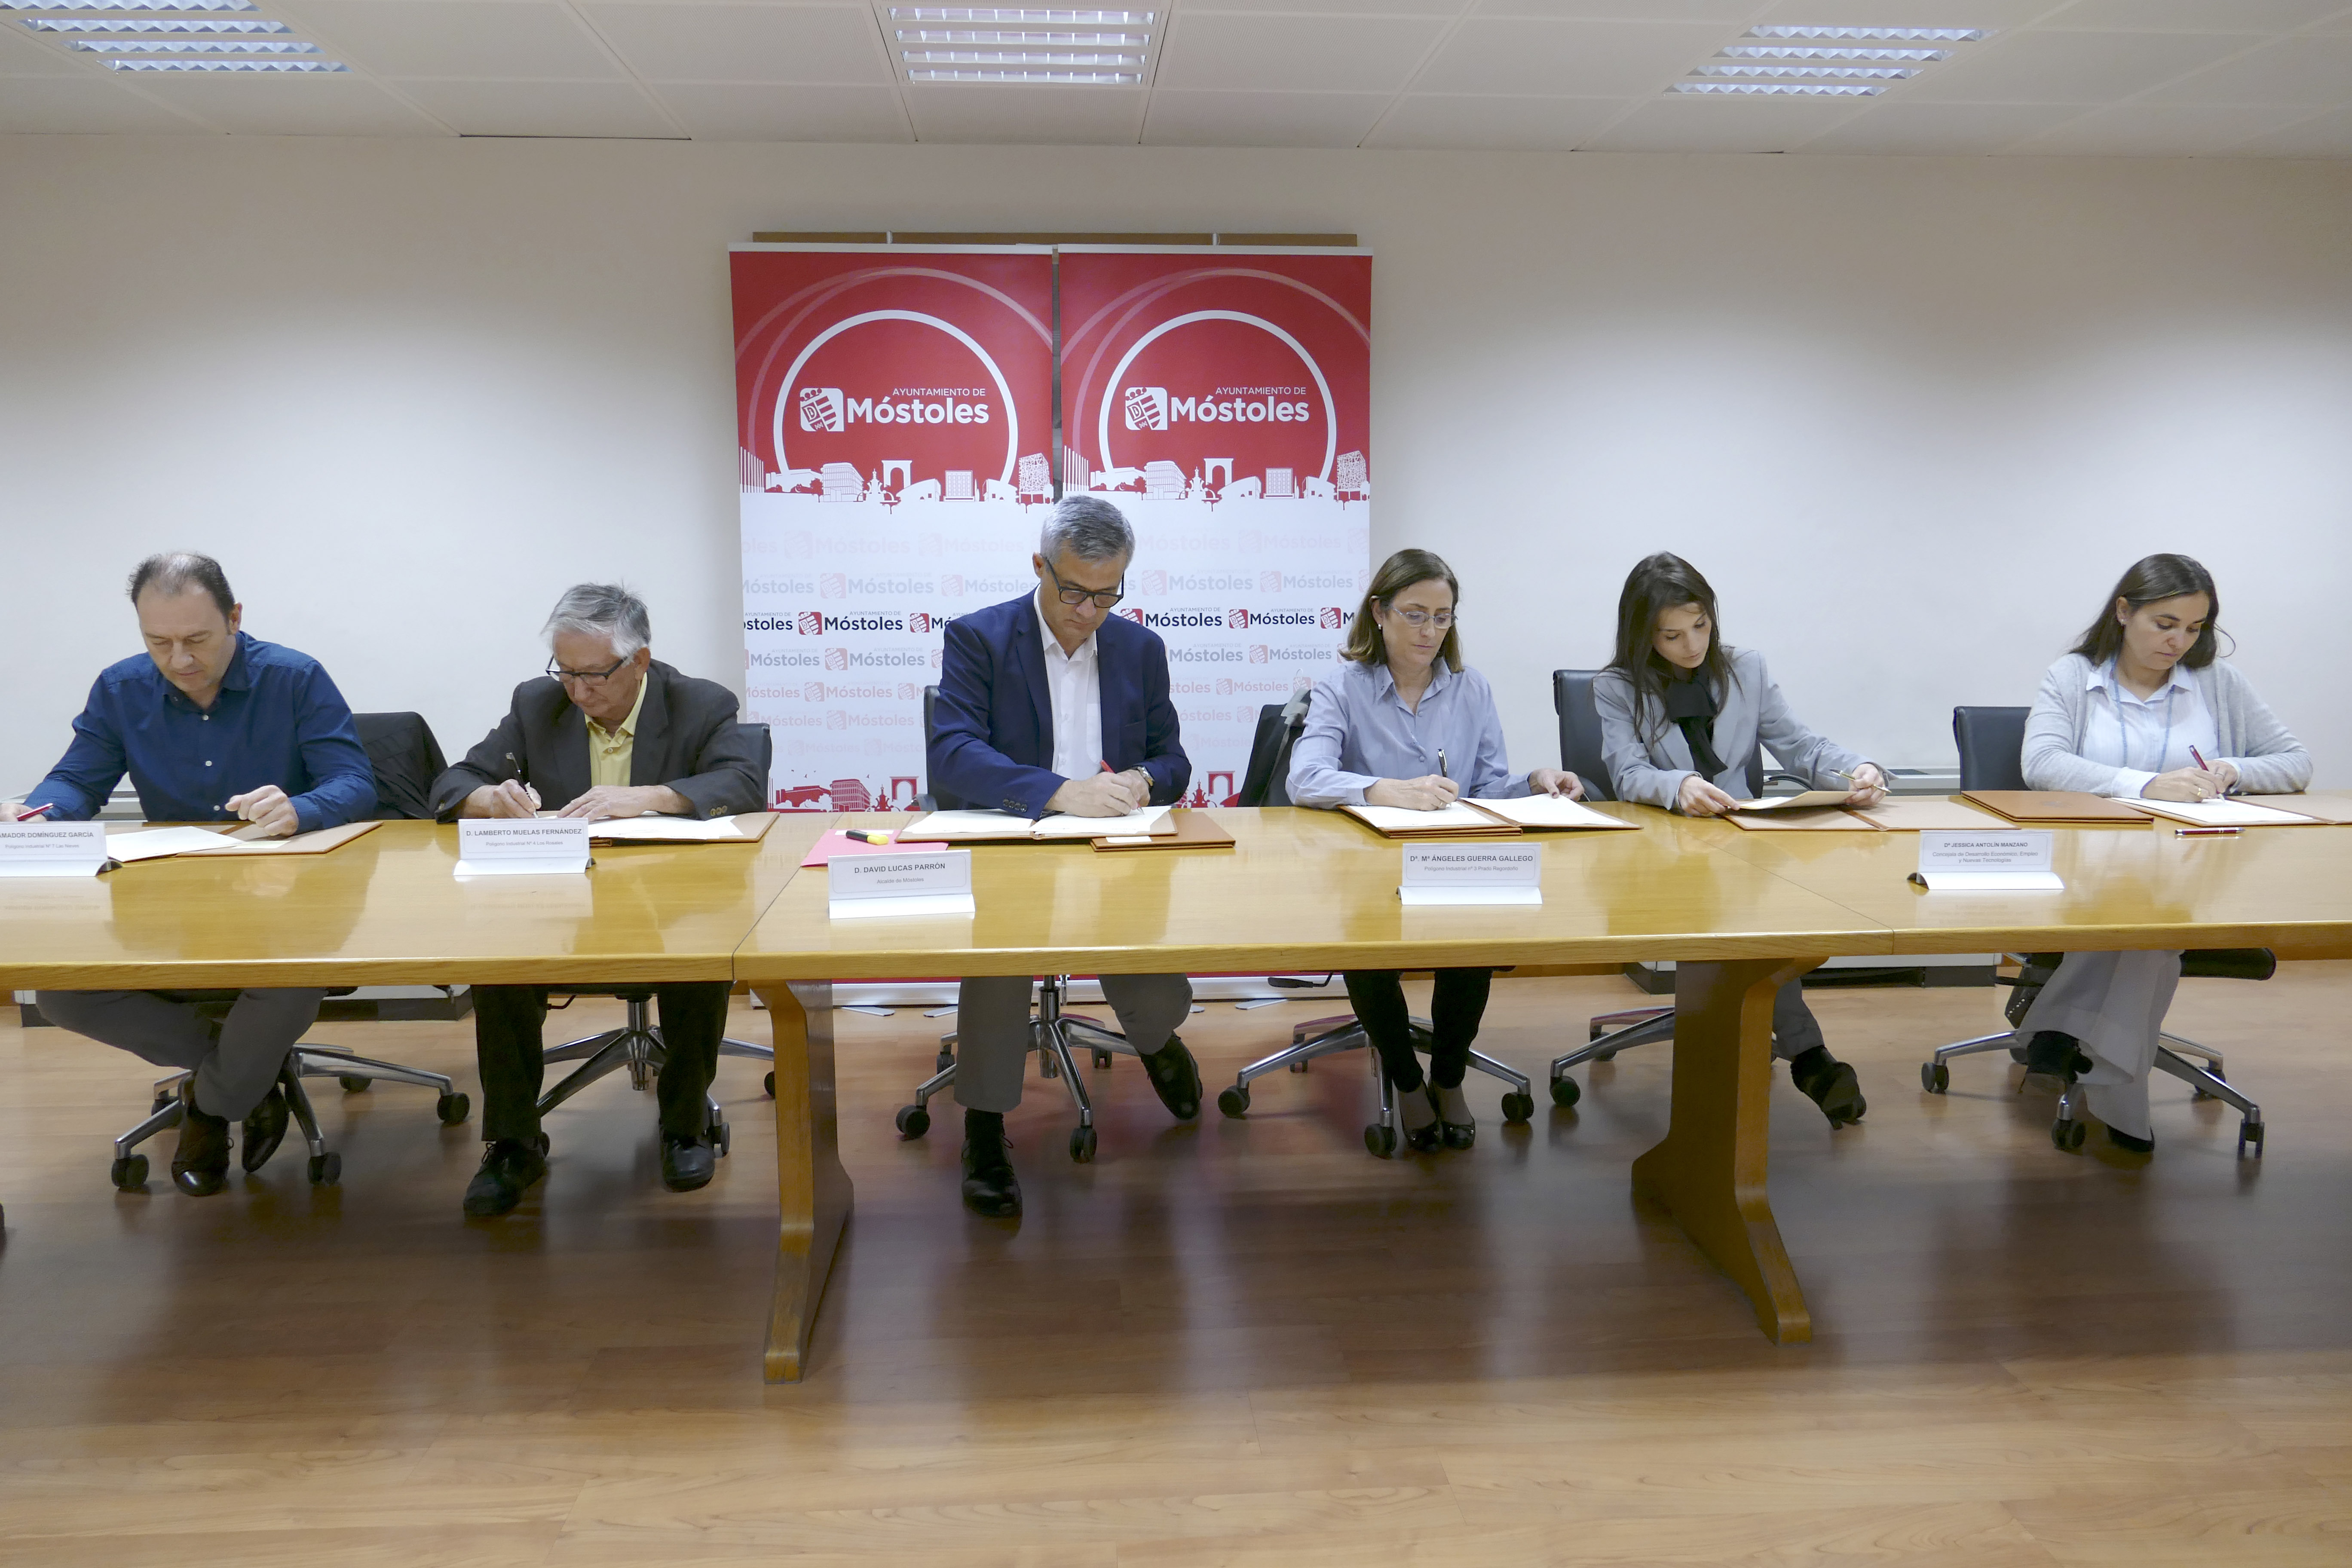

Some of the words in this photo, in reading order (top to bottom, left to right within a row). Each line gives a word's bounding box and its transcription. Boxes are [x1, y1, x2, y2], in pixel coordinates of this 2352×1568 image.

[847, 396, 989, 423] Móstoles
[1171, 395, 1309, 422] Móstoles
[848, 578, 934, 594] Móstoles
[1169, 574, 1253, 590] Móstoles
[1283, 575, 1353, 588] Móstoles
[744, 617, 793, 630] stoles
[825, 616, 903, 630] Móstoles
[1145, 612, 1222, 627] Móstoles
[1250, 612, 1315, 625] Móstoles
[750, 653, 820, 666] Móstoles
[849, 652, 925, 666] Móstoles
[1170, 648, 1243, 662] Móstoles
[1270, 648, 1332, 660] Móstoles
[827, 685, 892, 698] Móstoles
[1234, 681, 1289, 692] Móstoles
[761, 715, 822, 726] Móstoles
[848, 714, 915, 726] Móstoles
[915, 862, 945, 870] PARRÓN
